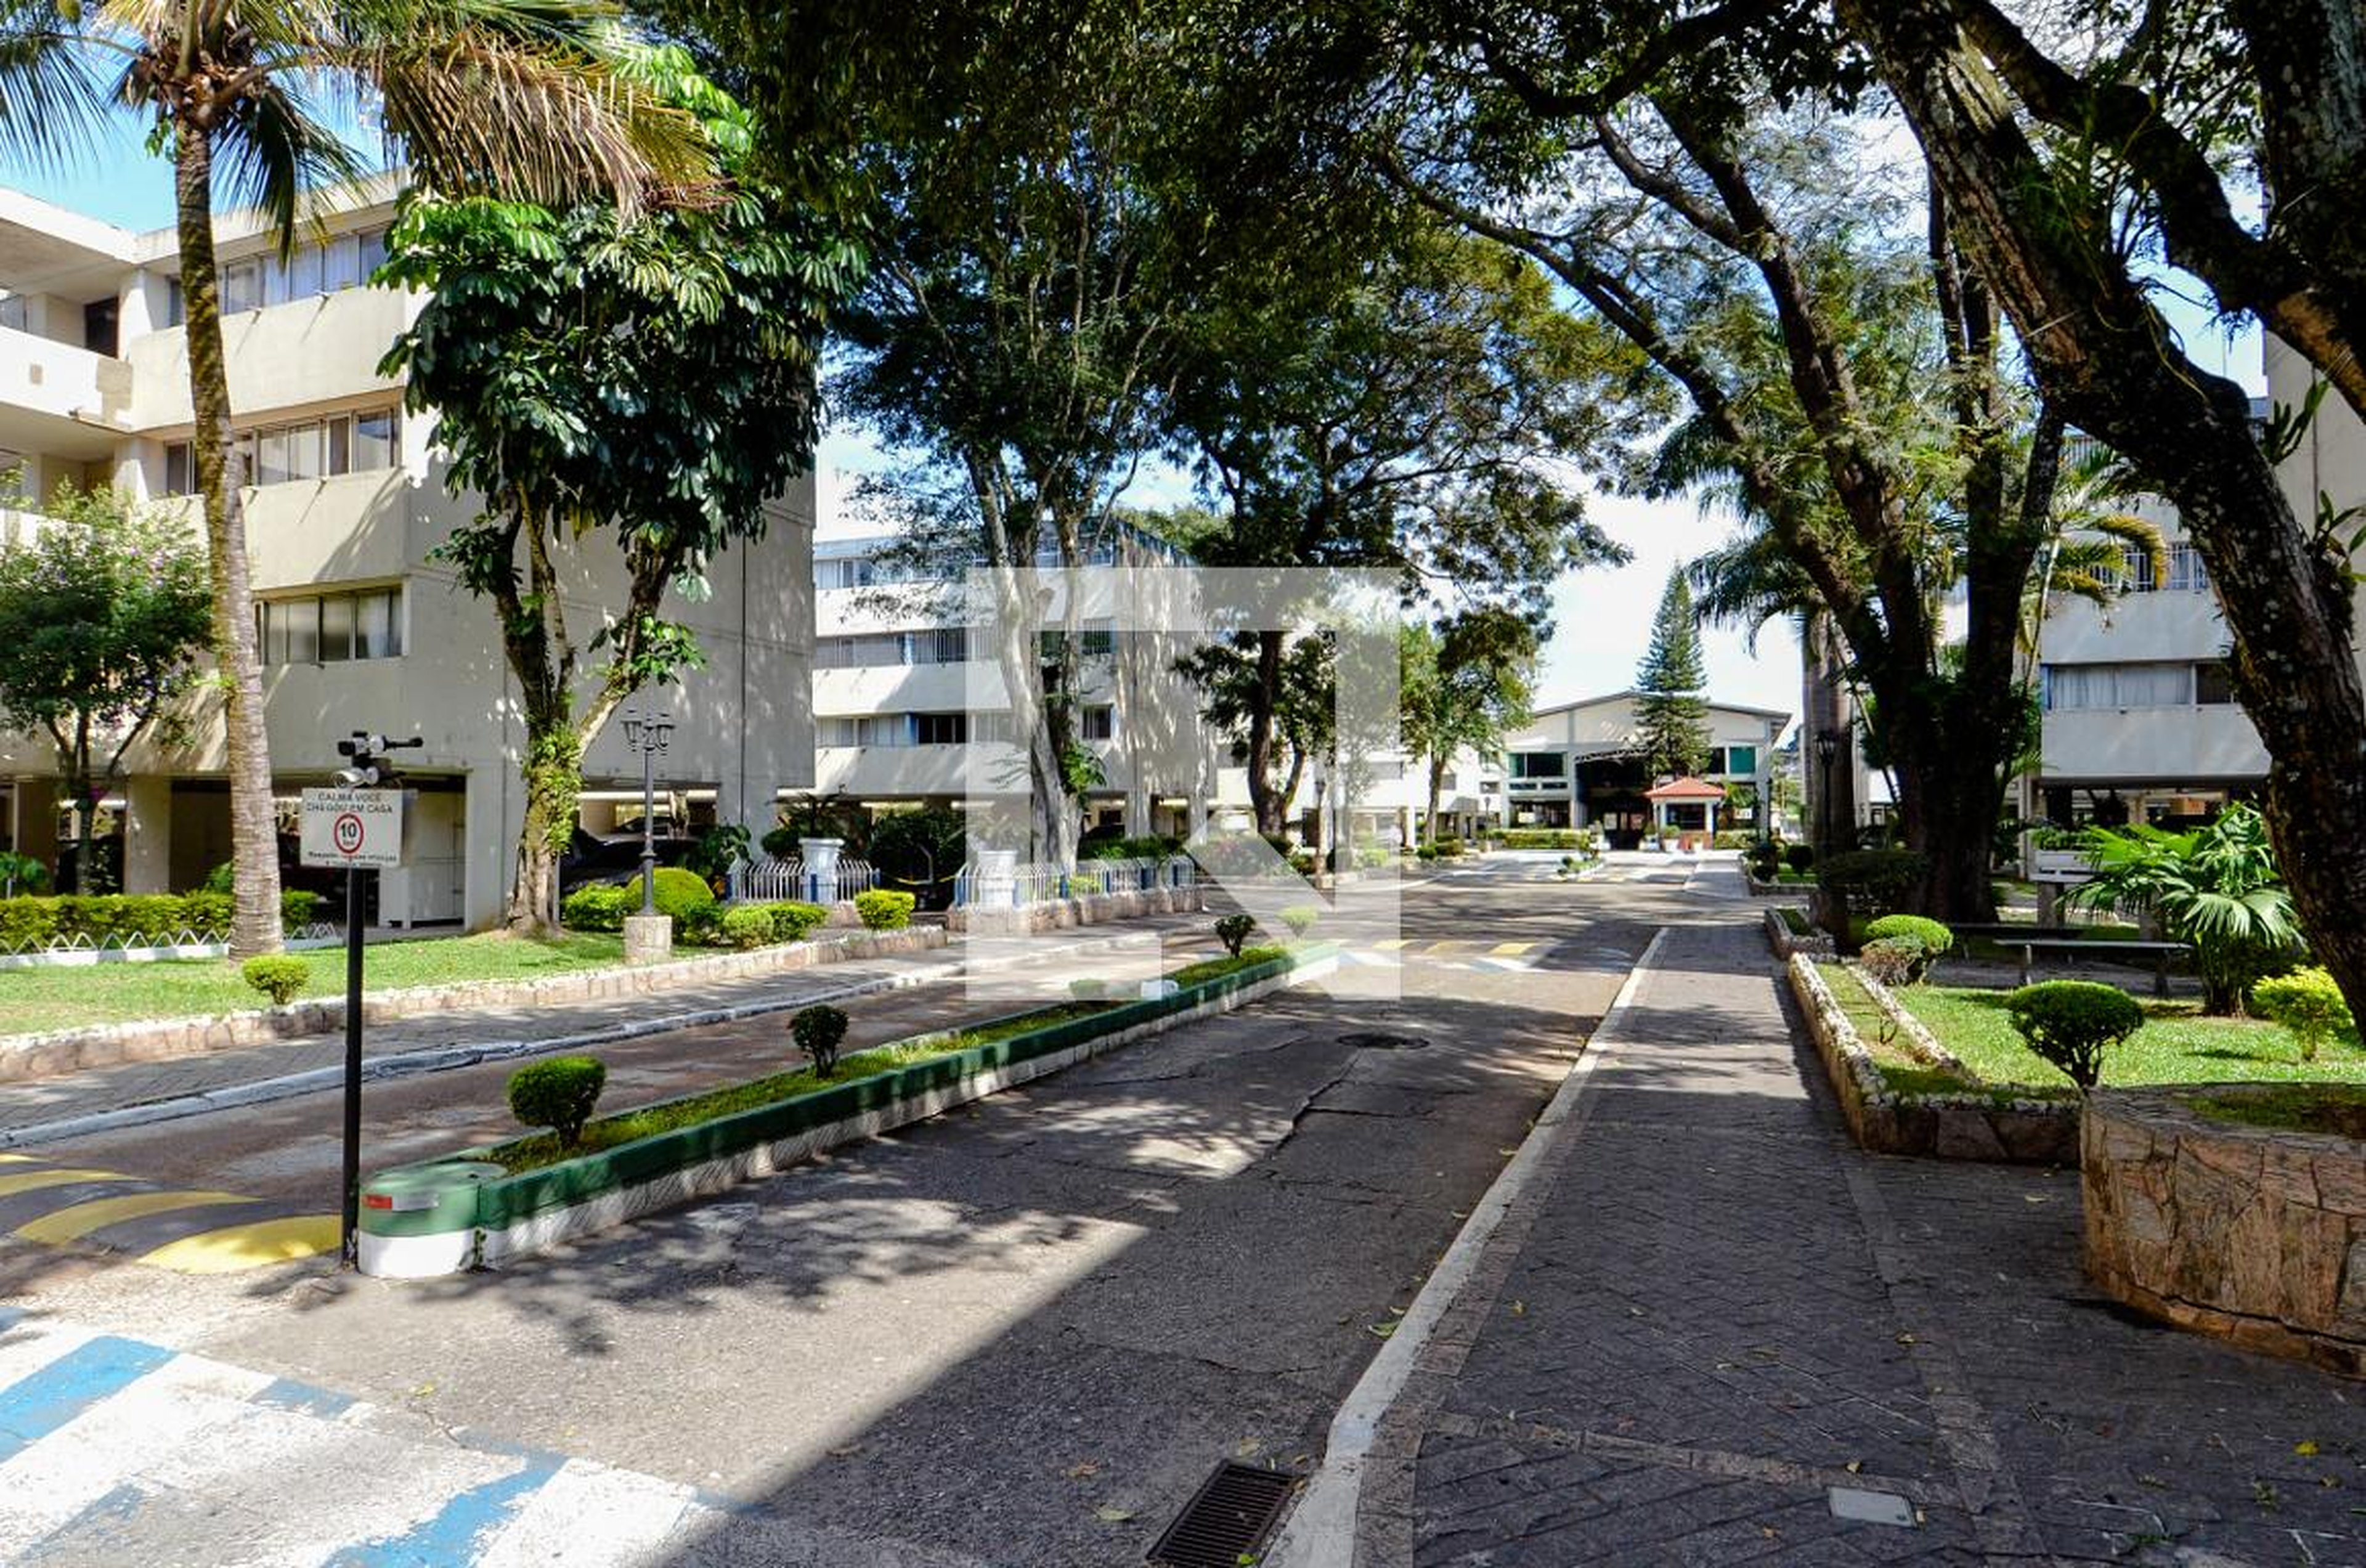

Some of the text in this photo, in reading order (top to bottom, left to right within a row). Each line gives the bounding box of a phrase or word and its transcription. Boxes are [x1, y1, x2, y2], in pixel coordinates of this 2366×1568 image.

[318, 793, 352, 801] CALMA
[307, 802, 393, 813] CHEGOU EM CASA
[340, 823, 357, 838] 10
